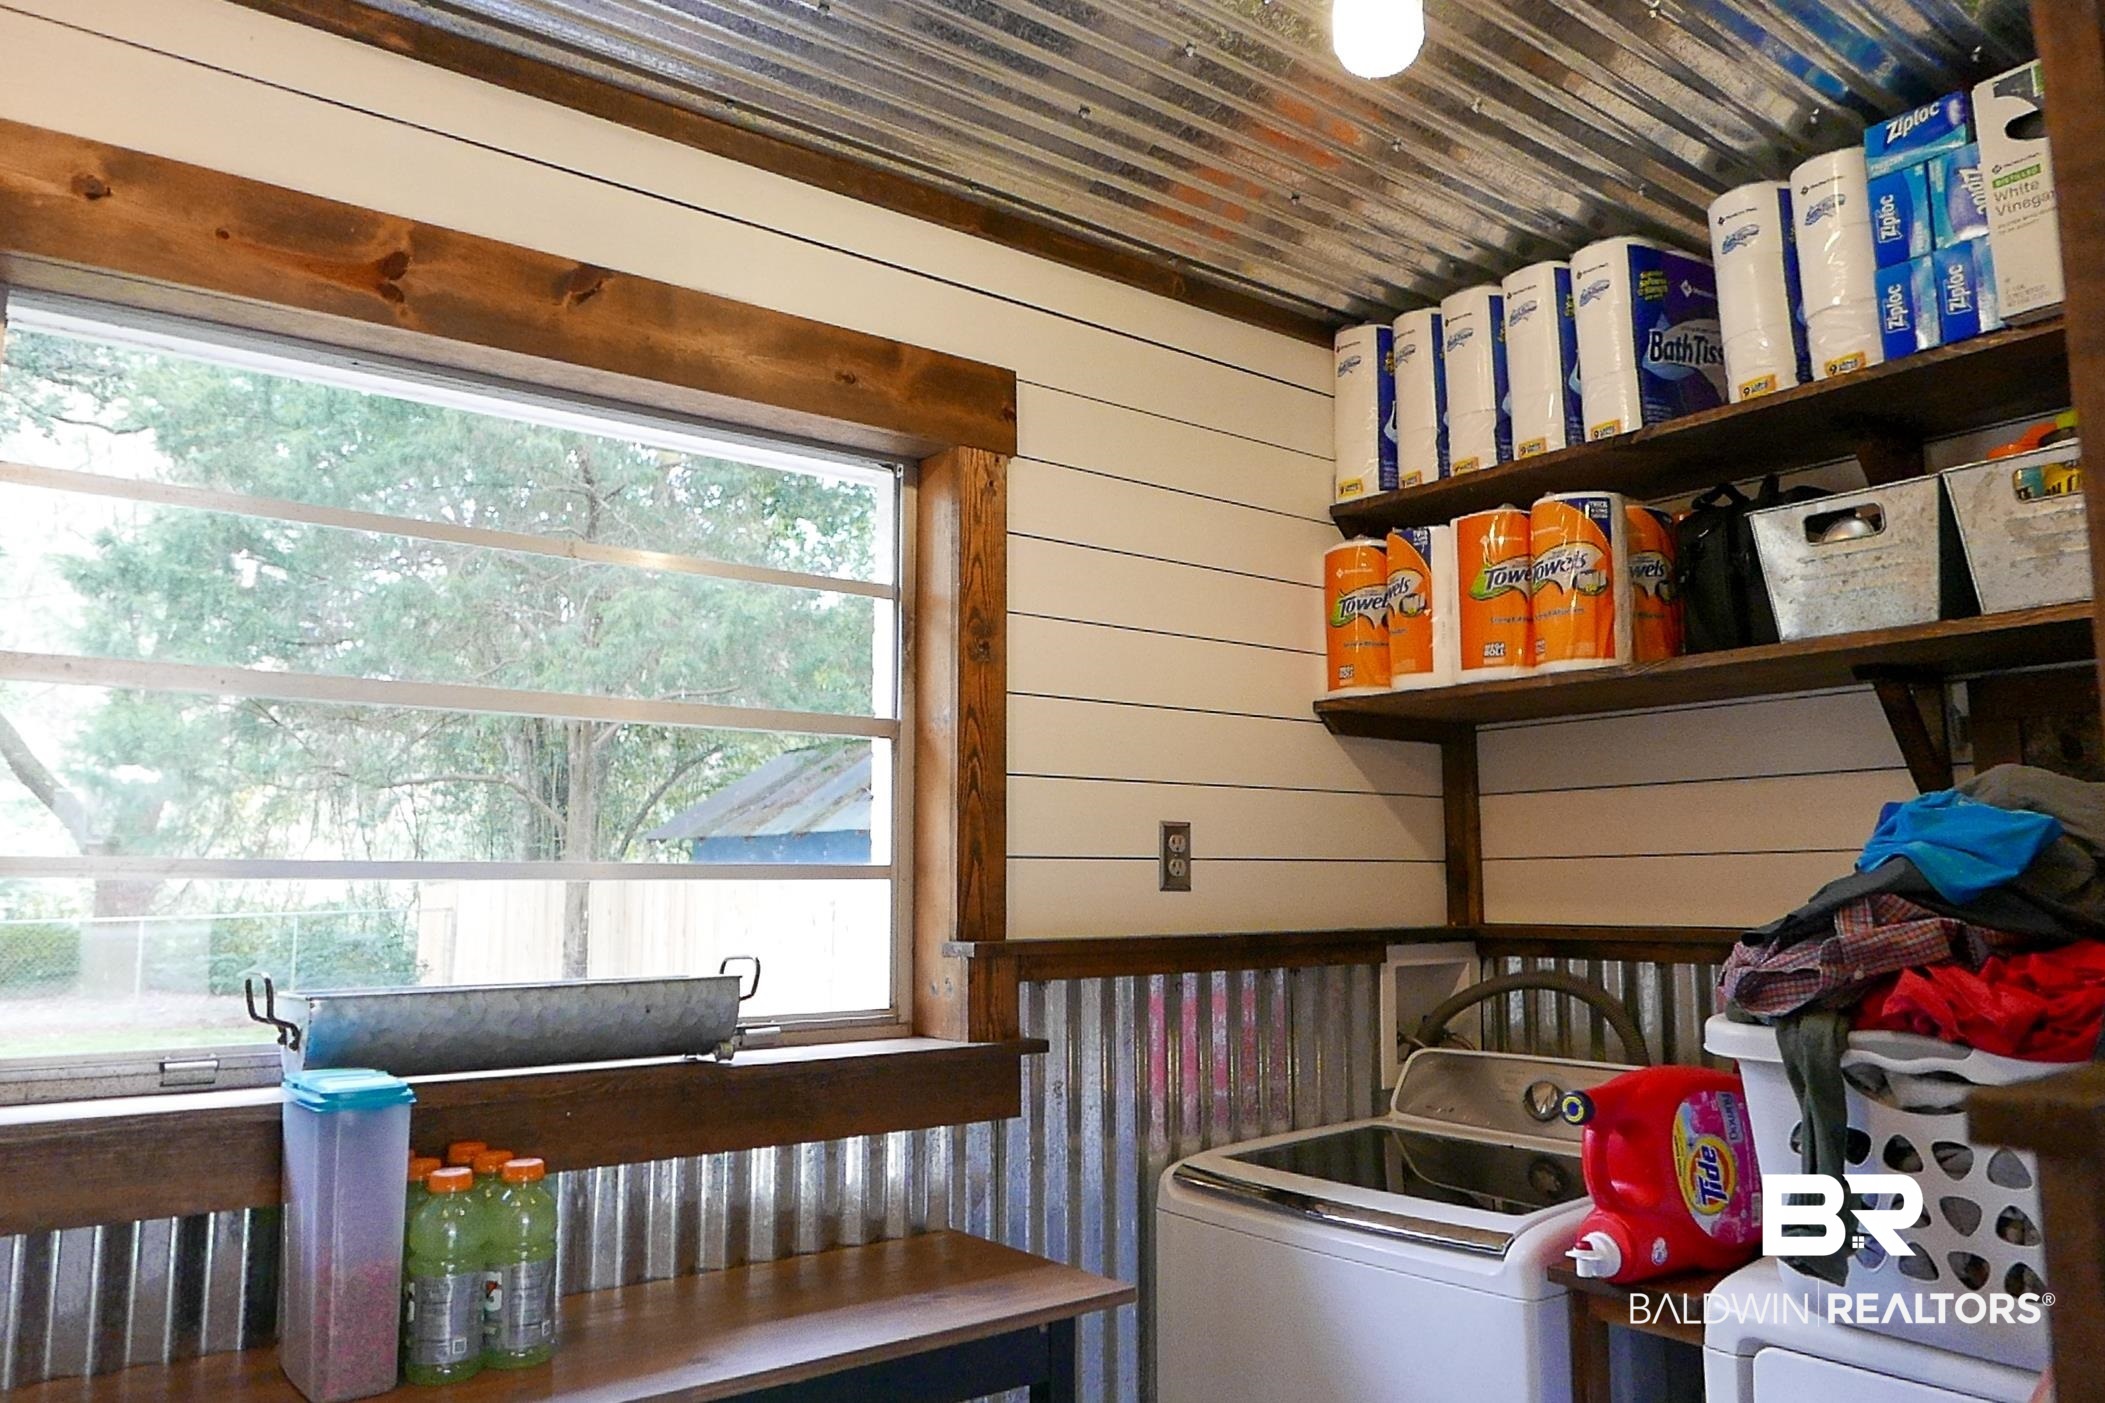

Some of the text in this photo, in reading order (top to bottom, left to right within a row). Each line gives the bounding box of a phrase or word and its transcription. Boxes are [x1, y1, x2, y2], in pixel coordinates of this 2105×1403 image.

[1886, 102, 1940, 144] Ziploc
[1994, 179, 2040, 202] White
[1880, 194, 1902, 240] Ziploc
[1887, 284, 1909, 330] Ziploc
[1948, 264, 1971, 312] Ziploc
[1697, 1145, 1729, 1206] Tide
